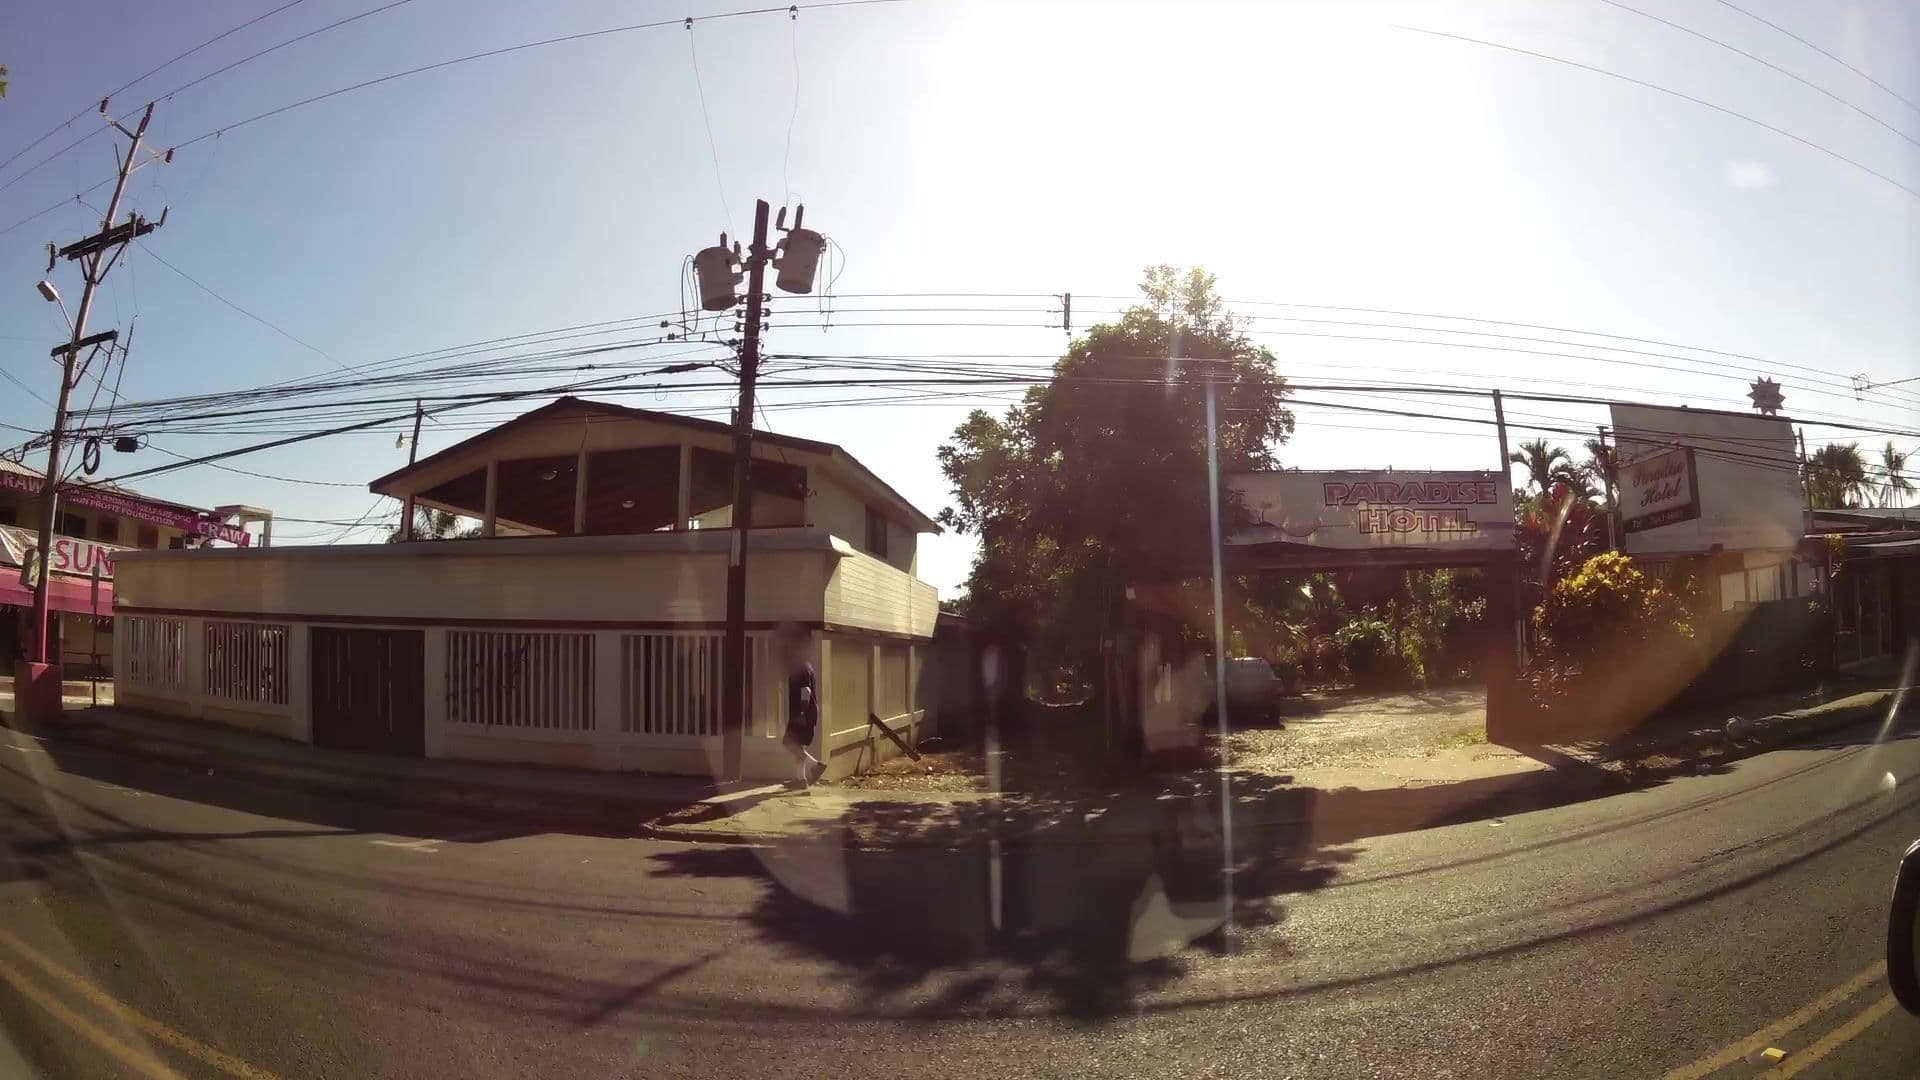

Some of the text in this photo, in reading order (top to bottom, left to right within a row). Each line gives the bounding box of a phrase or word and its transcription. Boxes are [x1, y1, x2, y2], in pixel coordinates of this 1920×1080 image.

[1323, 481, 1498, 506] PARADISE
[196, 521, 246, 545] CRAW
[1358, 508, 1477, 534] HOTEL
